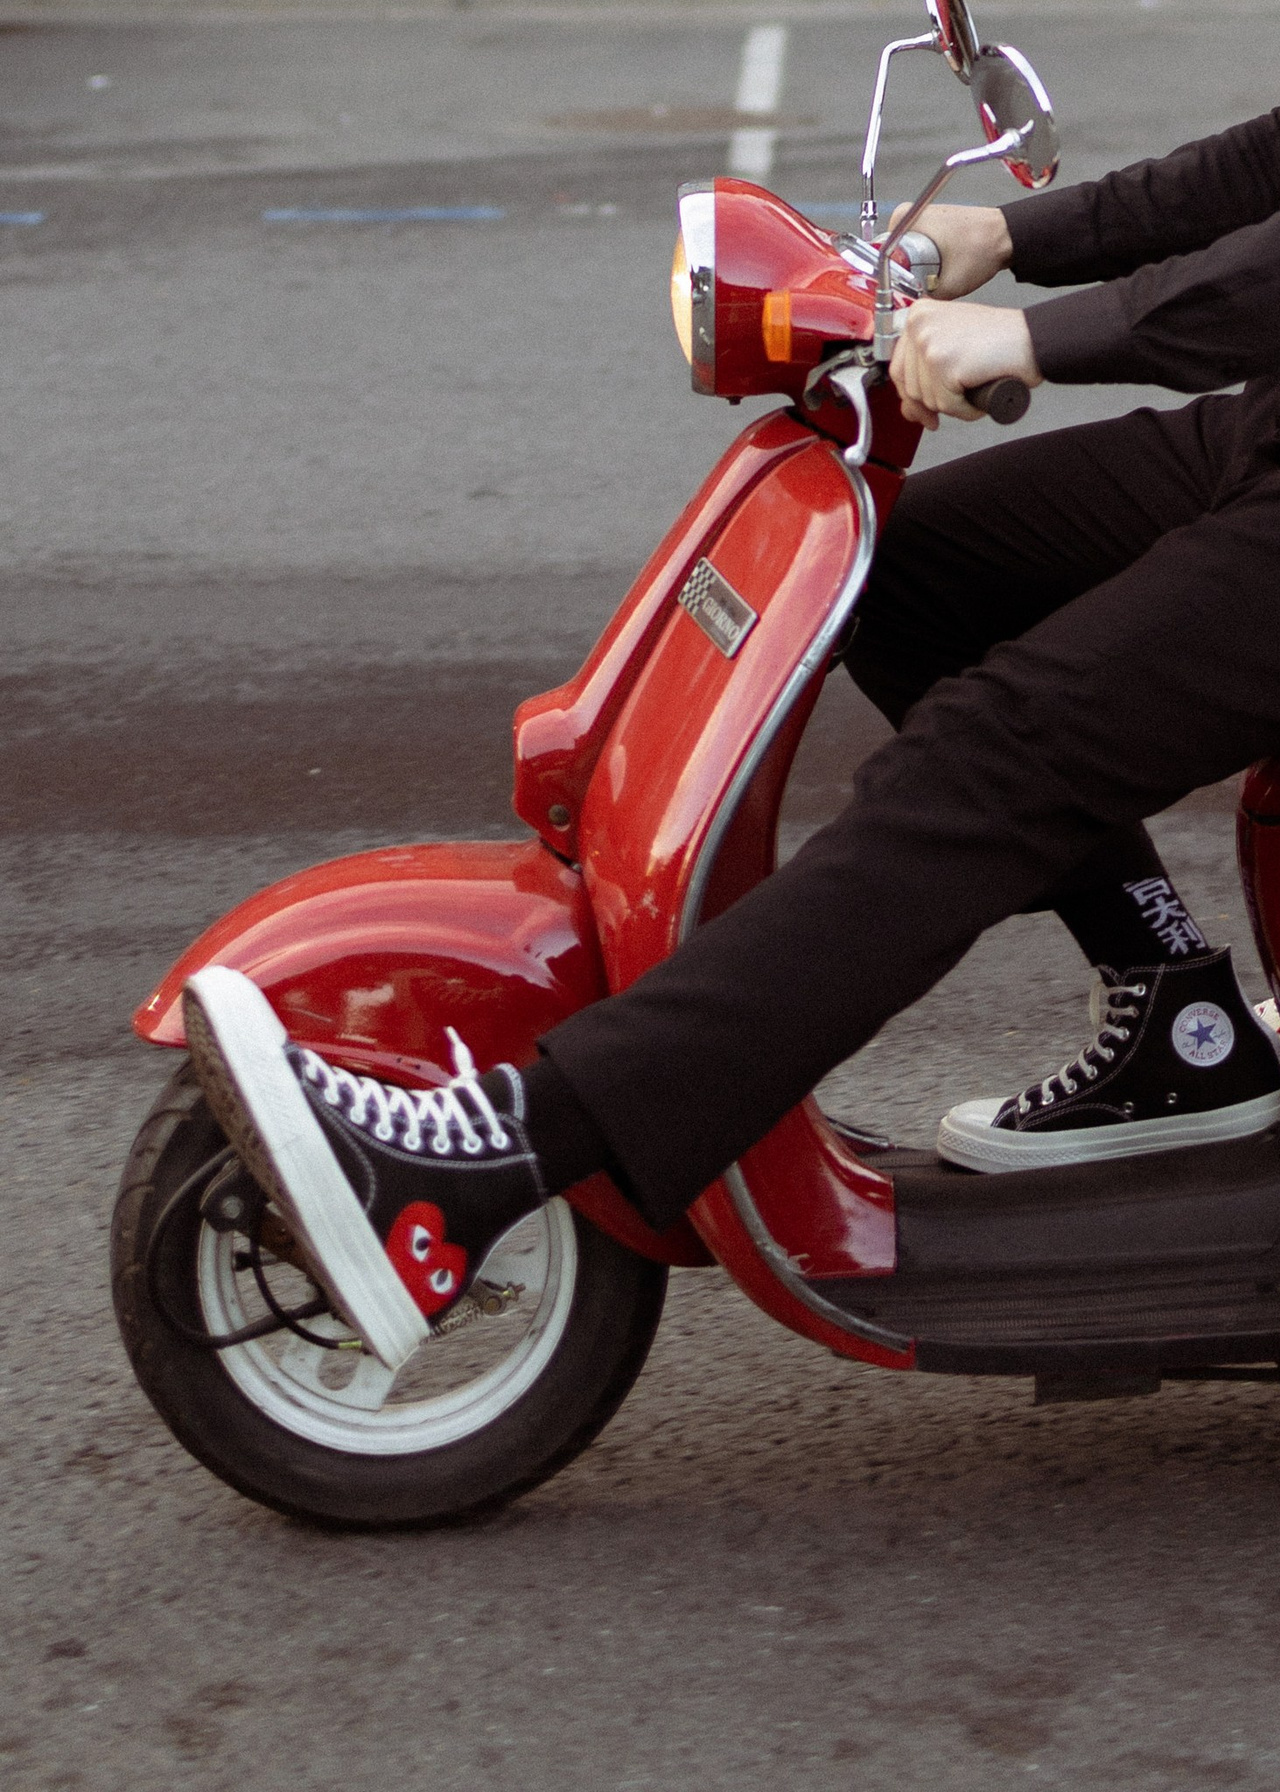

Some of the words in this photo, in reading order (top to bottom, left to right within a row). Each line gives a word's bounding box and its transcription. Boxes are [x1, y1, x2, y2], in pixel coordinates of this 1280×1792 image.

[702, 596, 741, 641] GIORNO
[1179, 1008, 1219, 1033] CONVERSE
[1189, 1050, 1206, 1060] ALL
[1208, 1039, 1228, 1059] STAR
